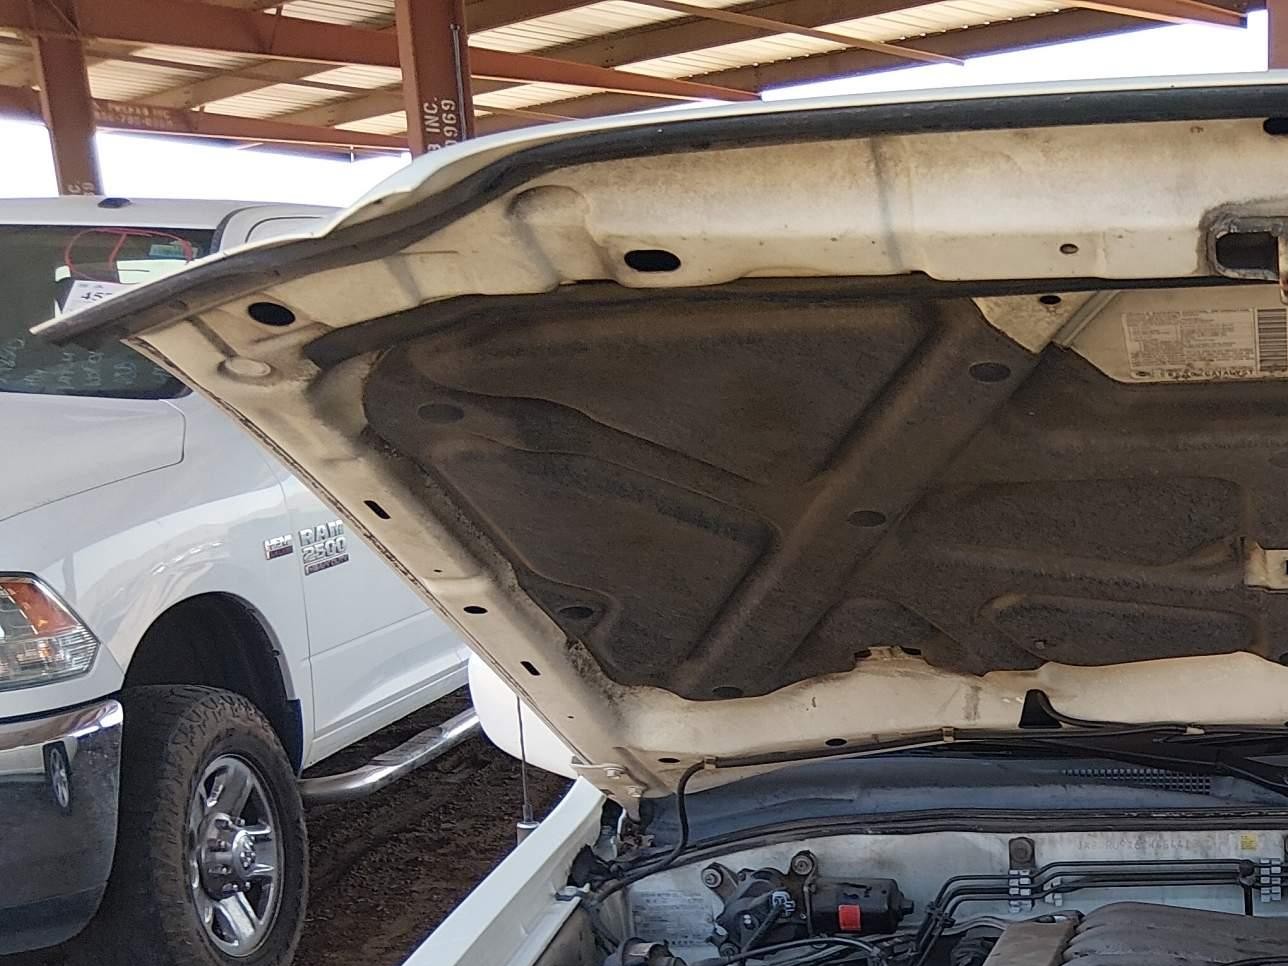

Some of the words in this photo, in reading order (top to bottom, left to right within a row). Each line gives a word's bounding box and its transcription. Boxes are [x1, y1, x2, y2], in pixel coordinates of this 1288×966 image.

[423, 97, 440, 133] INC.
[299, 519, 344, 546] RAM
[302, 536, 346, 563] 2500
